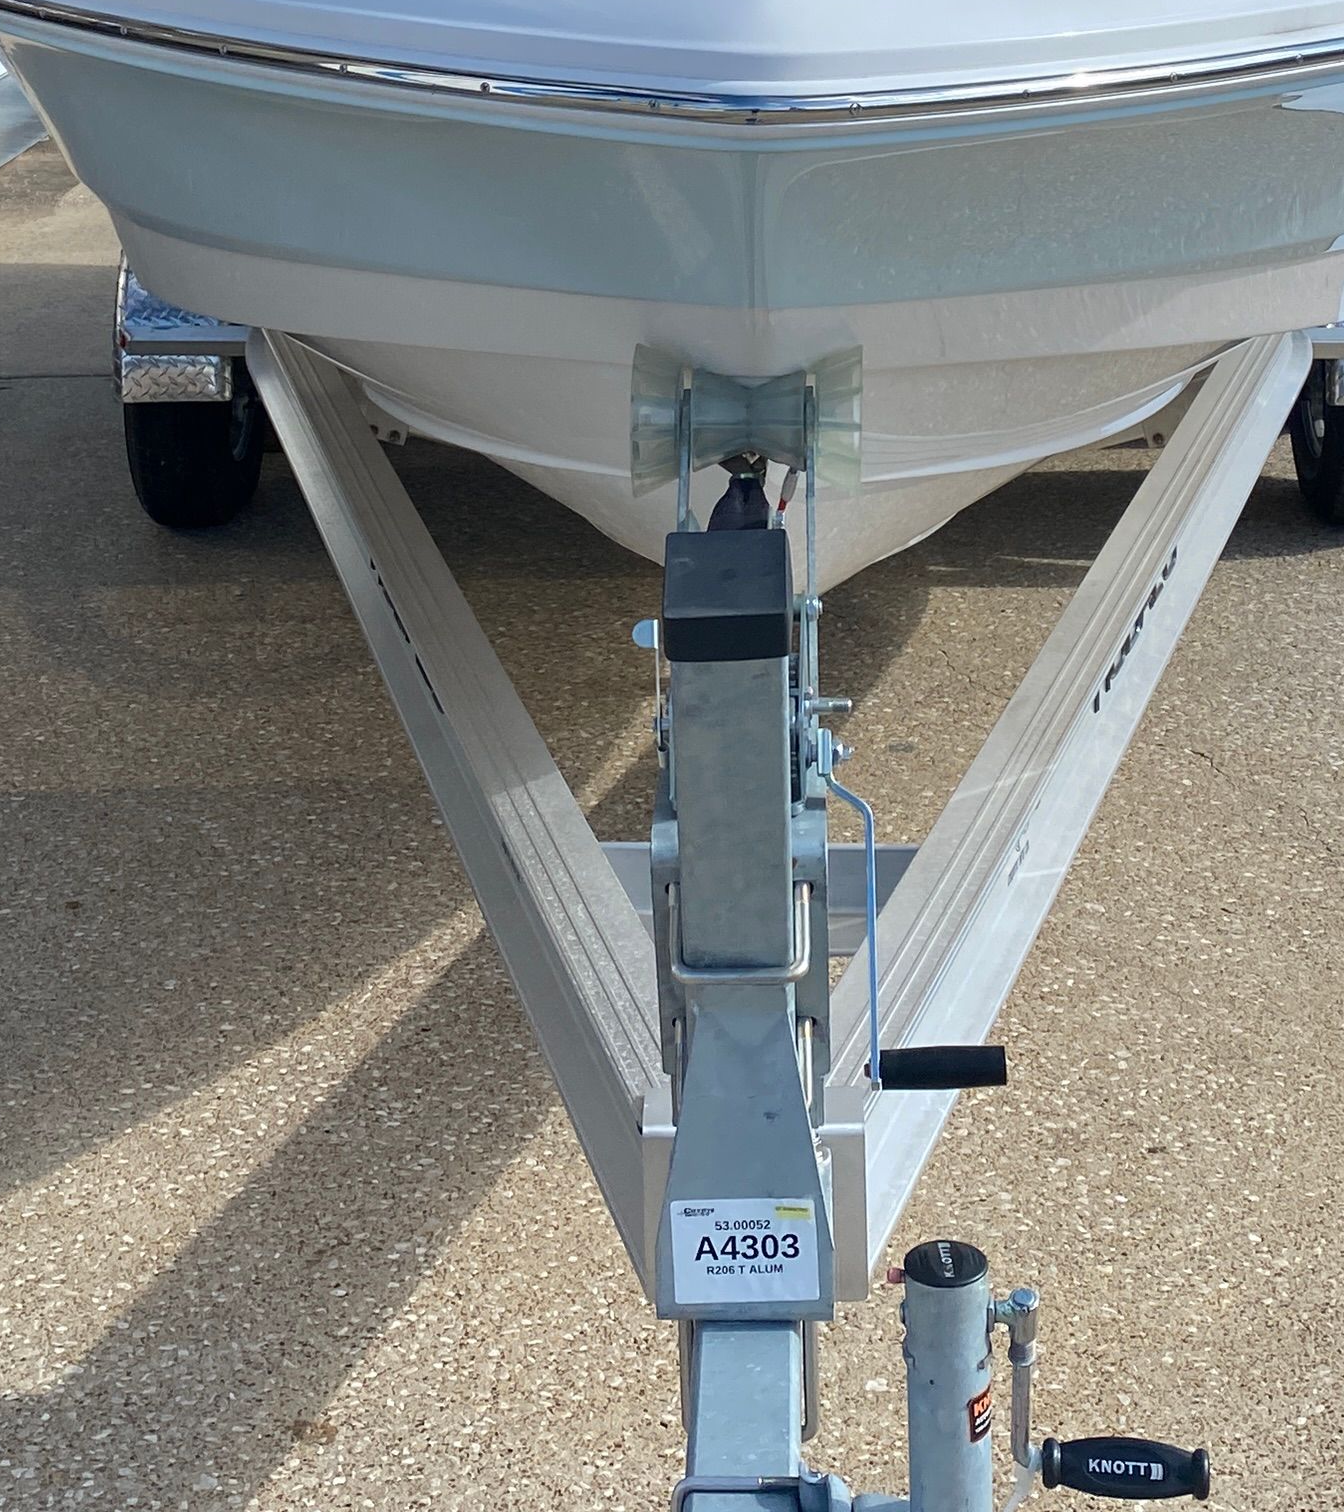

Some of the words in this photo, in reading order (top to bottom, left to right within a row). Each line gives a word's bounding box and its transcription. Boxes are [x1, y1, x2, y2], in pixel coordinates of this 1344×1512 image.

[714, 1219, 771, 1231] 53.00052
[694, 1233, 800, 1262] A4303
[706, 1265, 736, 1275] R206
[738, 1265, 746, 1275] T
[749, 1263, 784, 1274] ALUM
[1088, 1458, 1148, 1476] KNOTT
